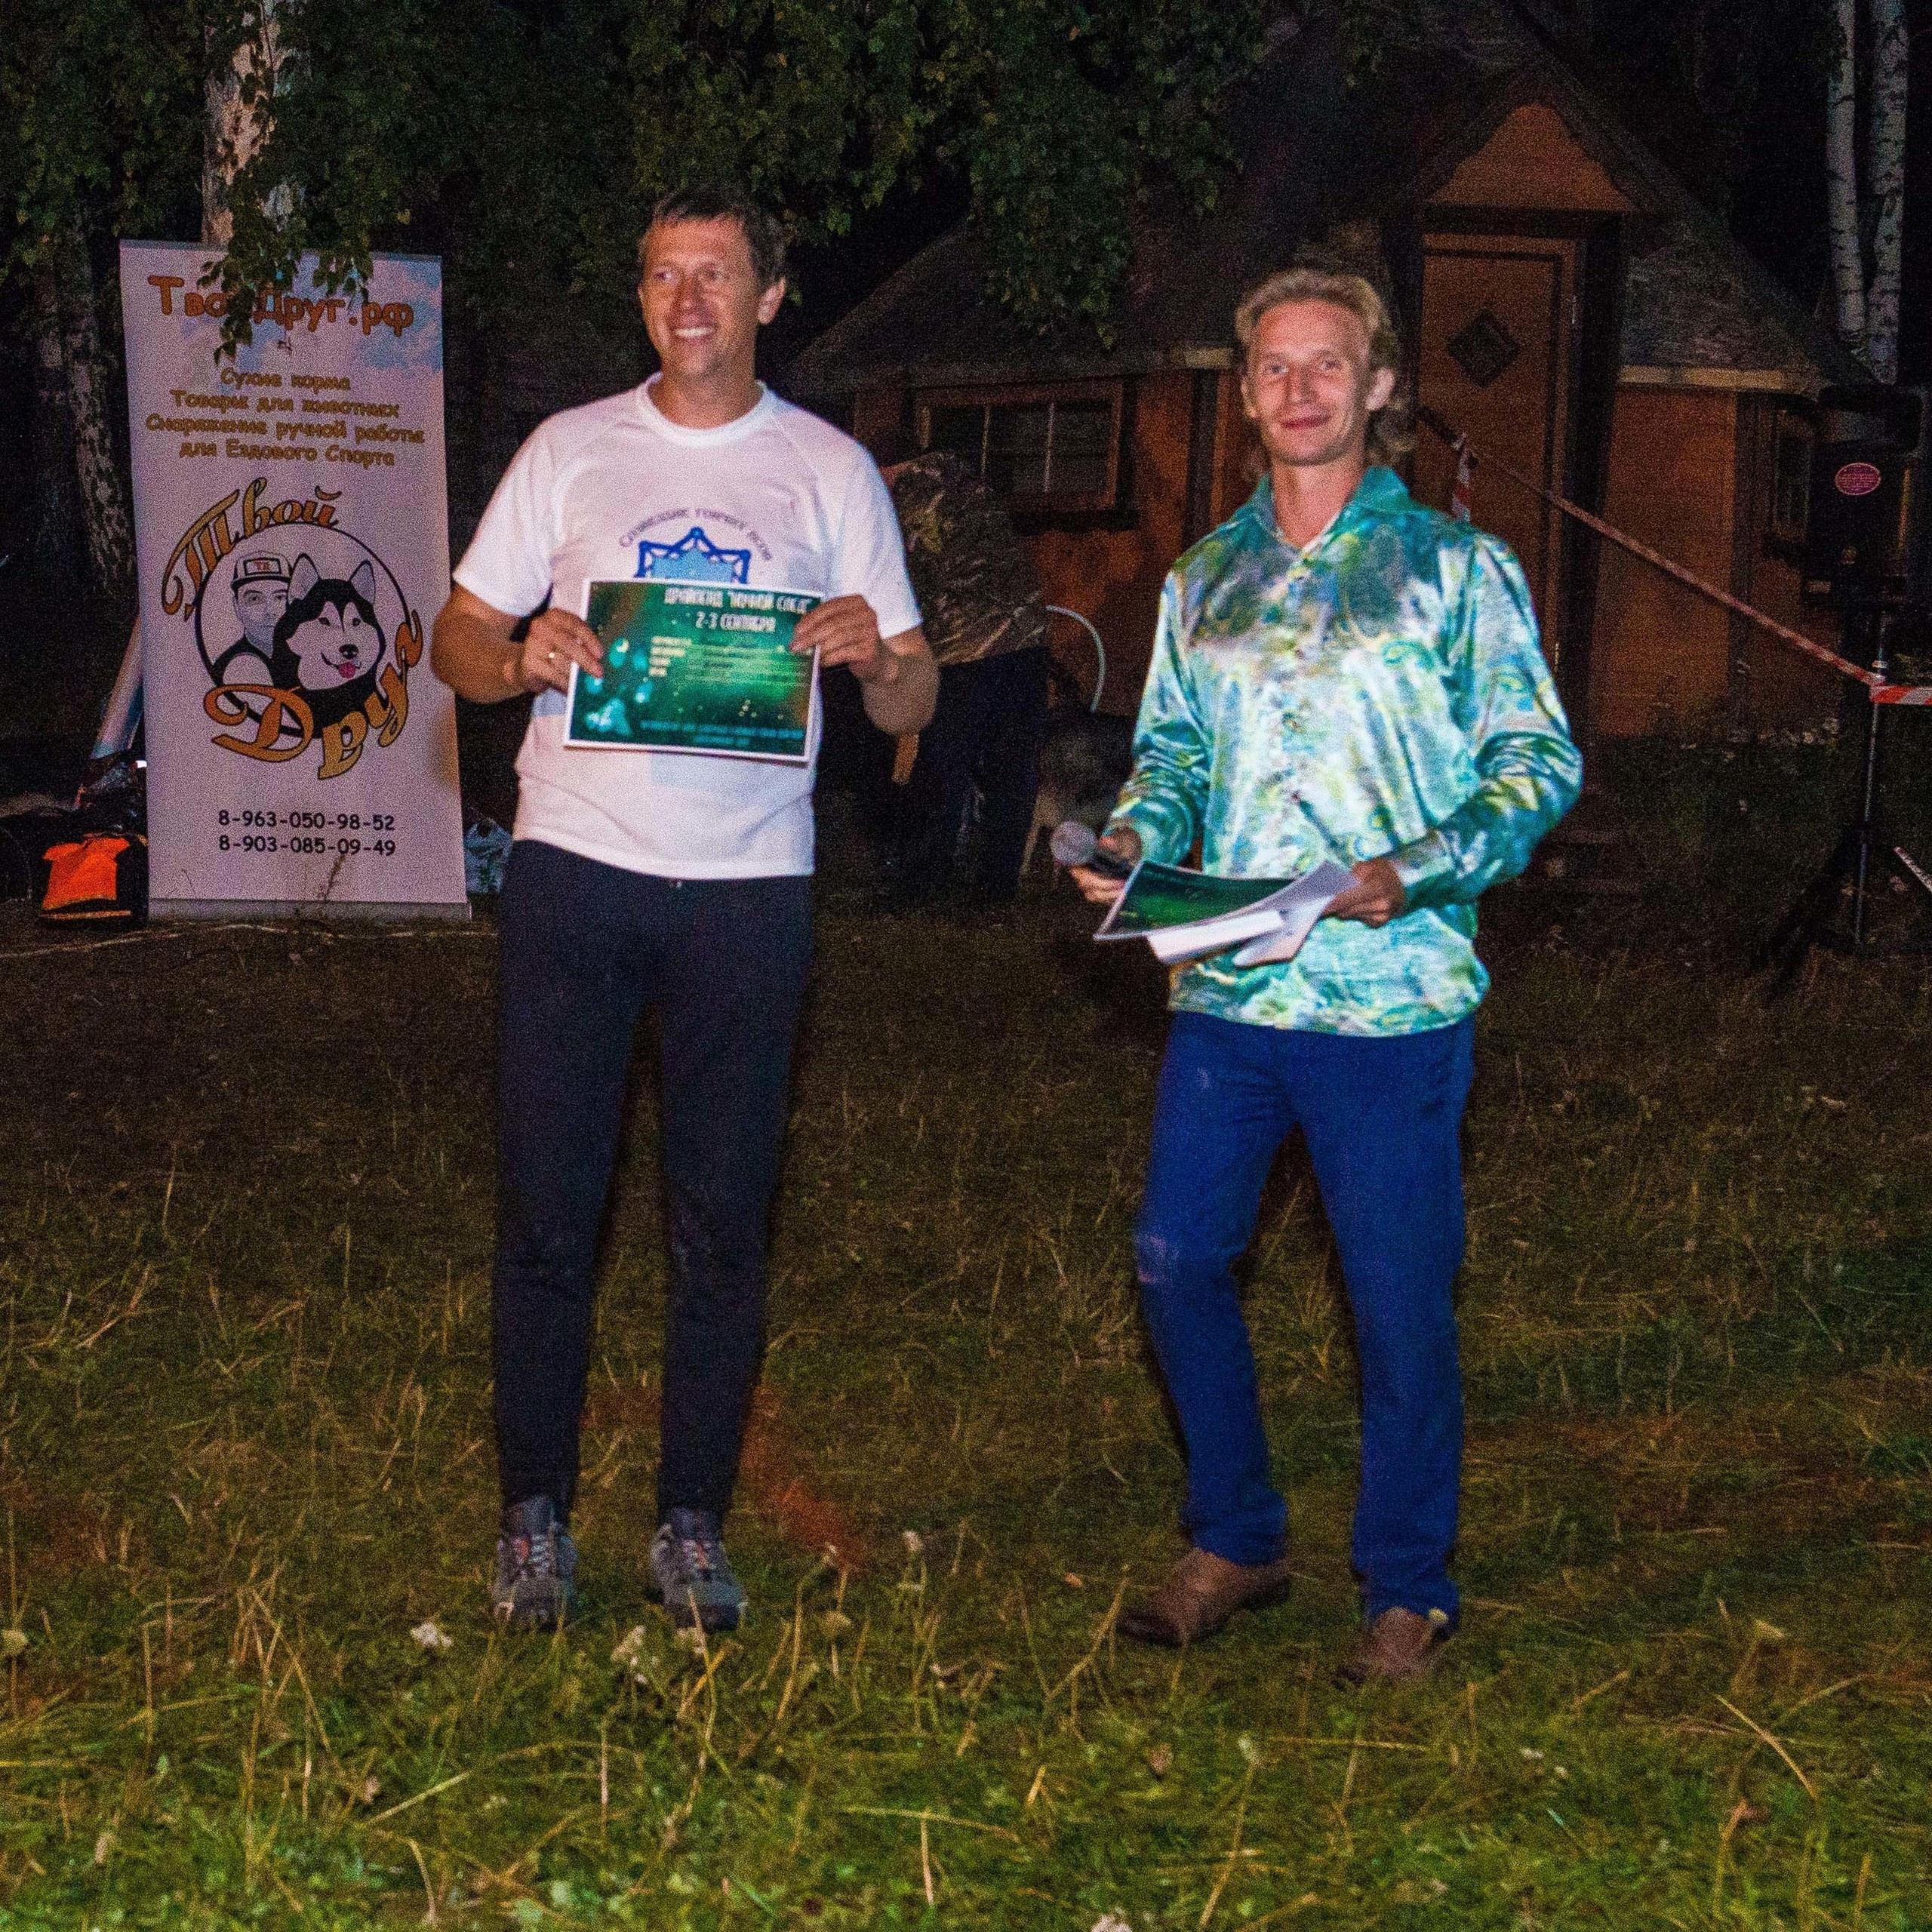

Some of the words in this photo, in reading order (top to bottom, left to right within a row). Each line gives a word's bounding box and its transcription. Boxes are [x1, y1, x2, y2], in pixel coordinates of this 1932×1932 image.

[147, 275, 414, 337] ТвоДруг.рф
[220, 367, 282, 389] Сухие
[291, 373, 351, 393] корма
[170, 389, 249, 414] Товары
[257, 396, 294, 413] для
[302, 398, 400, 419] животных
[146, 413, 268, 435] Снаряжение
[276, 419, 347, 440] ручной
[355, 423, 426, 444] работы
[180, 440, 217, 458] для
[226, 438, 318, 461] Ездового
[325, 445, 396, 469] Спорта
[162, 476, 342, 621] Твой
[203, 609, 424, 780] Друг
[218, 809, 395, 831] 8-963-050-98-52
[219, 834, 396, 857] 8-903-085-09-49
